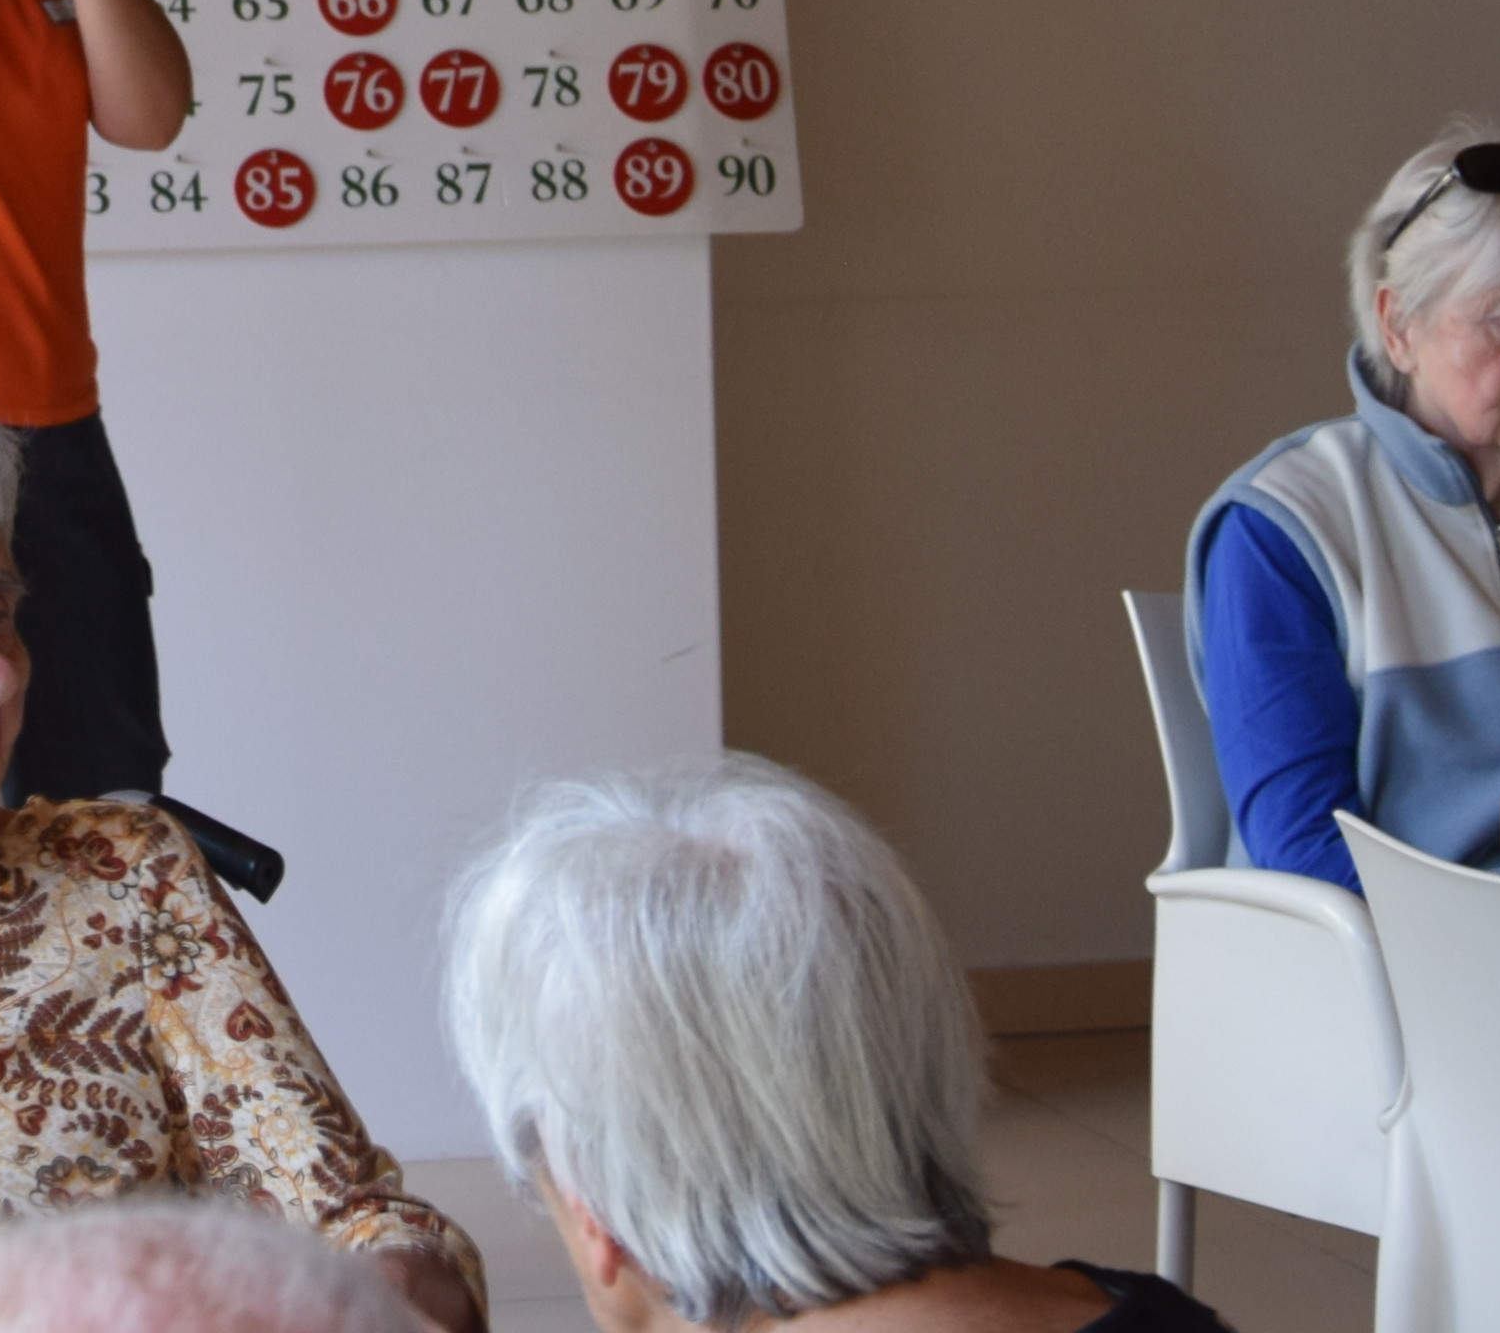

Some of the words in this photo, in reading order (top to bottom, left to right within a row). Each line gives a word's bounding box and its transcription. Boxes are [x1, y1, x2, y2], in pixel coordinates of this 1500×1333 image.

[237, 73, 296, 116] 75
[332, 70, 394, 114] 76
[427, 66, 486, 112] 77
[522, 65, 581, 108] 78
[617, 61, 677, 106] 79
[713, 60, 771, 104] 80
[87, 172, 110, 214] 3
[149, 171, 209, 213] 84
[243, 167, 303, 211] 85
[339, 165, 400, 208] 86
[435, 162, 492, 205] 87
[529, 159, 589, 202] 88
[624, 156, 683, 198] 89
[716, 155, 776, 196] 90
